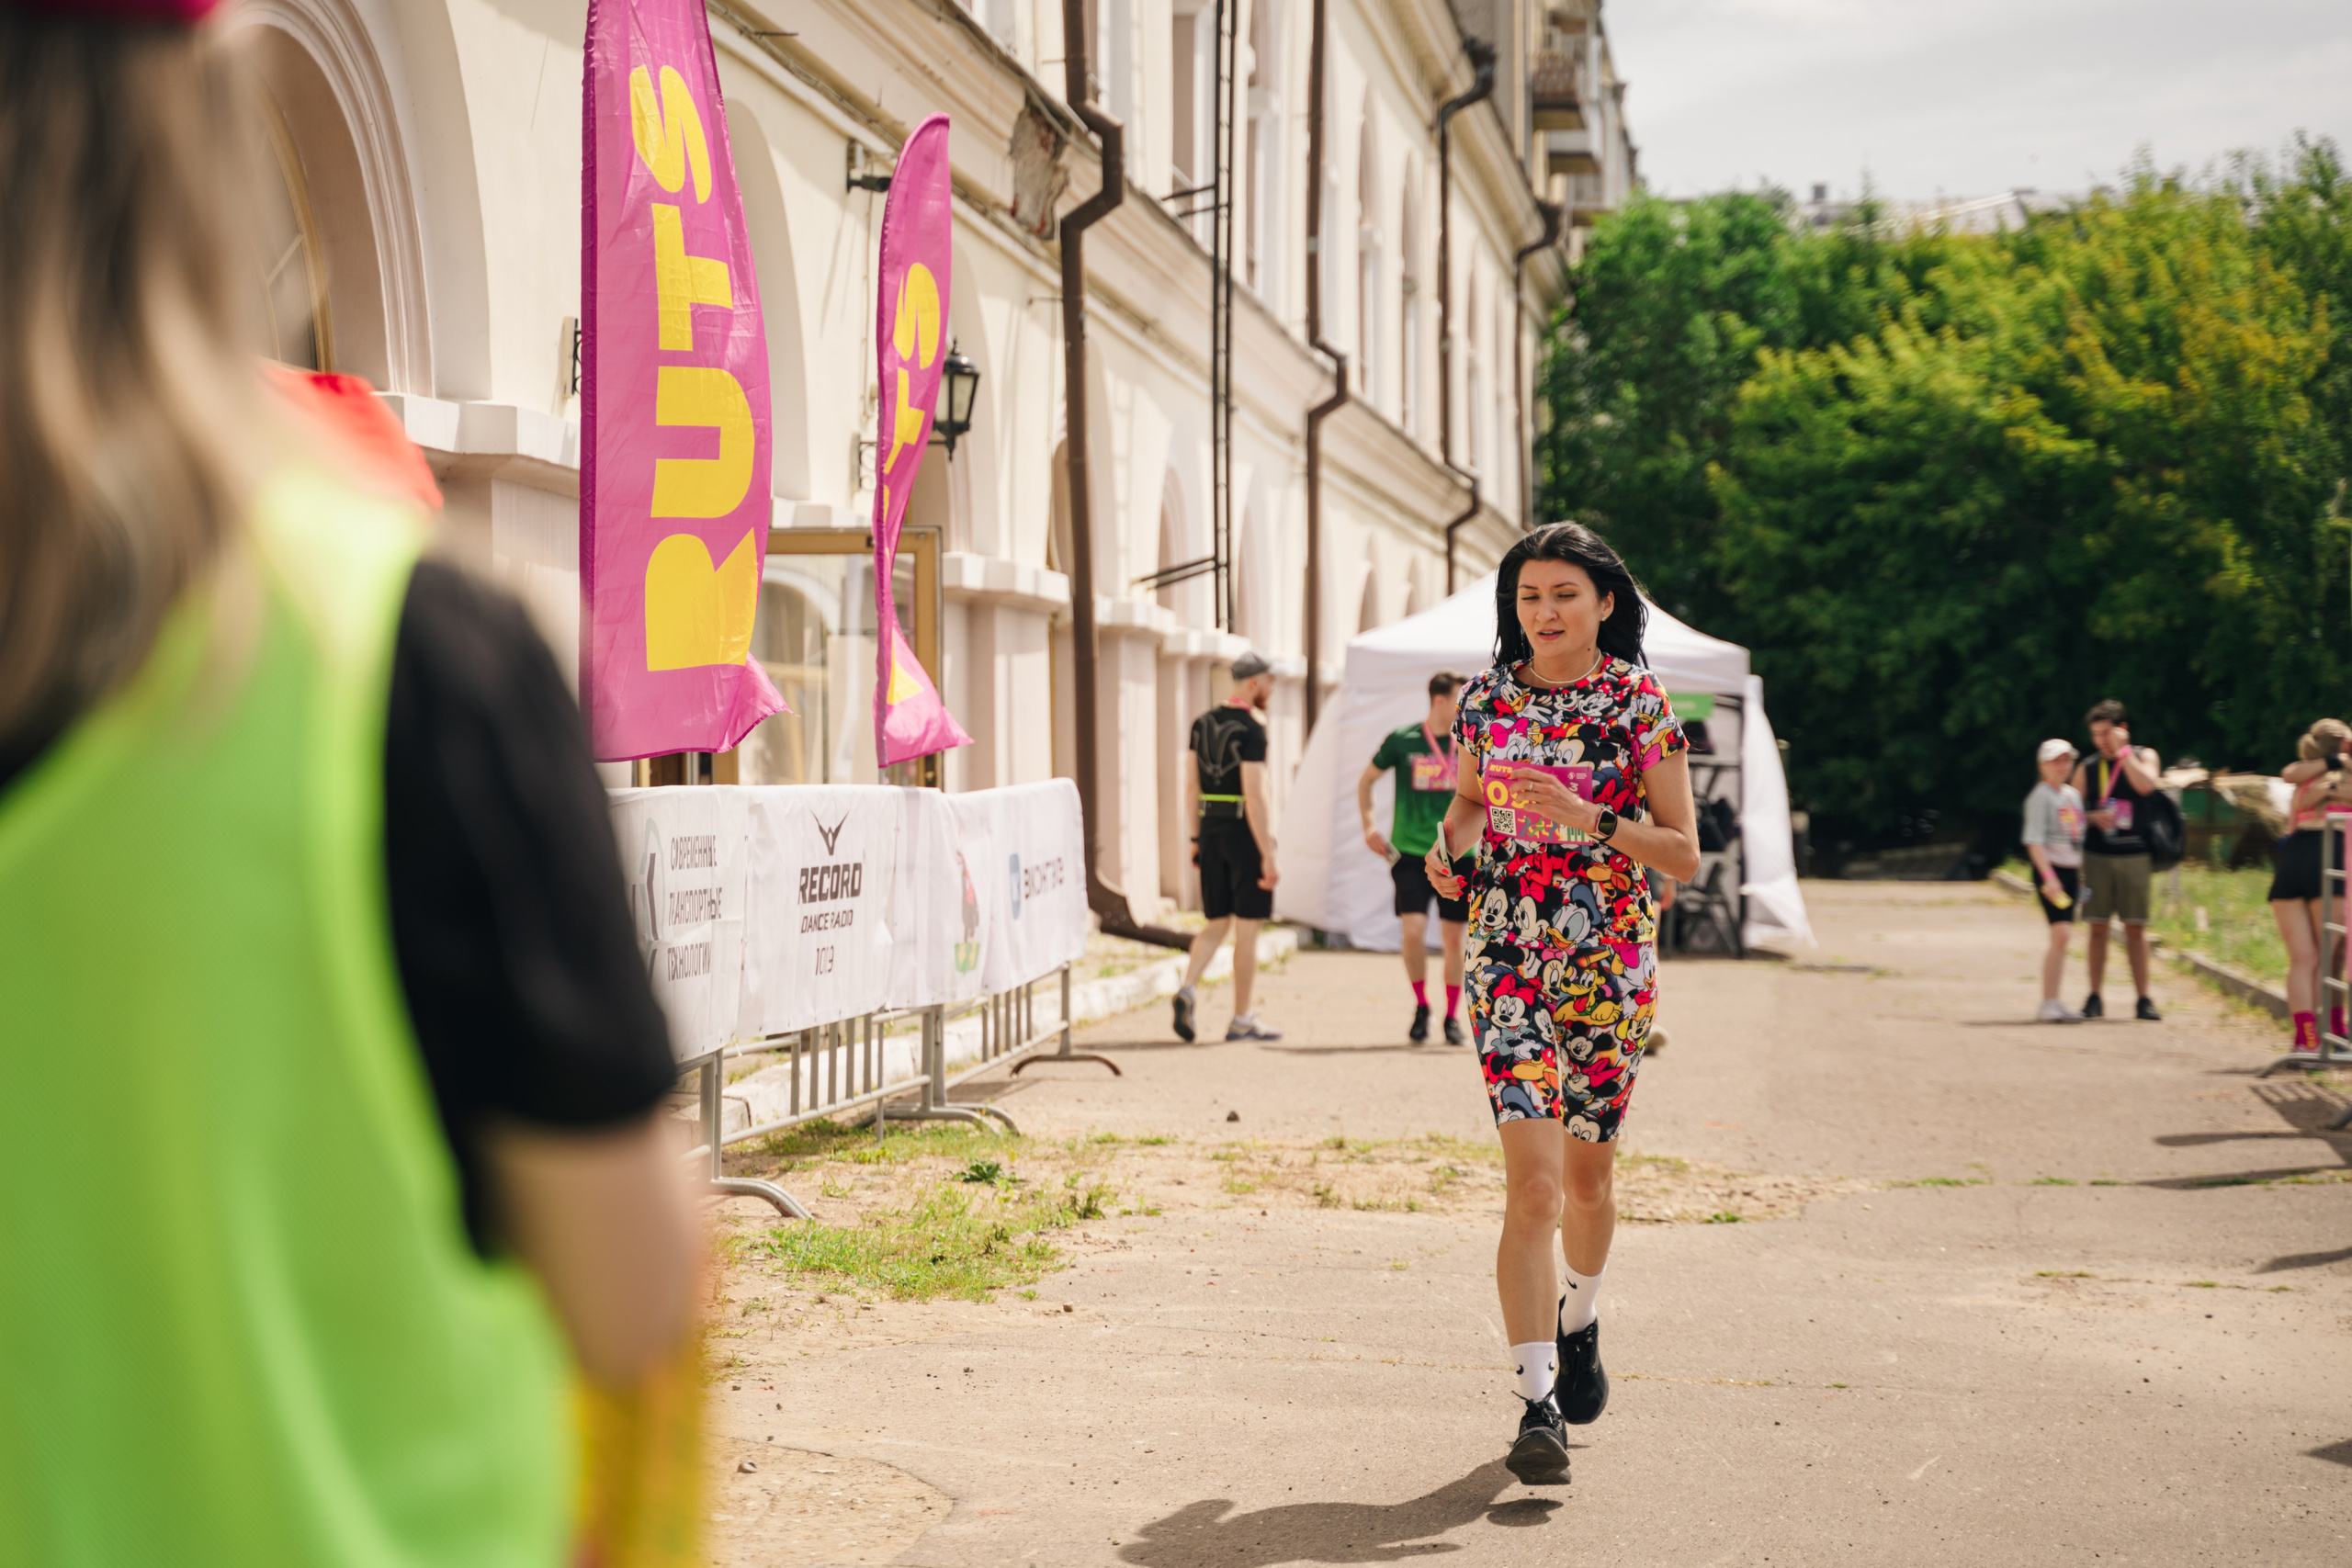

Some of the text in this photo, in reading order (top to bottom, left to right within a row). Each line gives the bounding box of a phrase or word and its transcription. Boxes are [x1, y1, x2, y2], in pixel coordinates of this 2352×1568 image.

[629, 64, 758, 671] RUTS
[1568, 782, 1579, 792] 3
[797, 863, 862, 905] RECORD
[800, 908, 854, 933] DANCE RADIO
